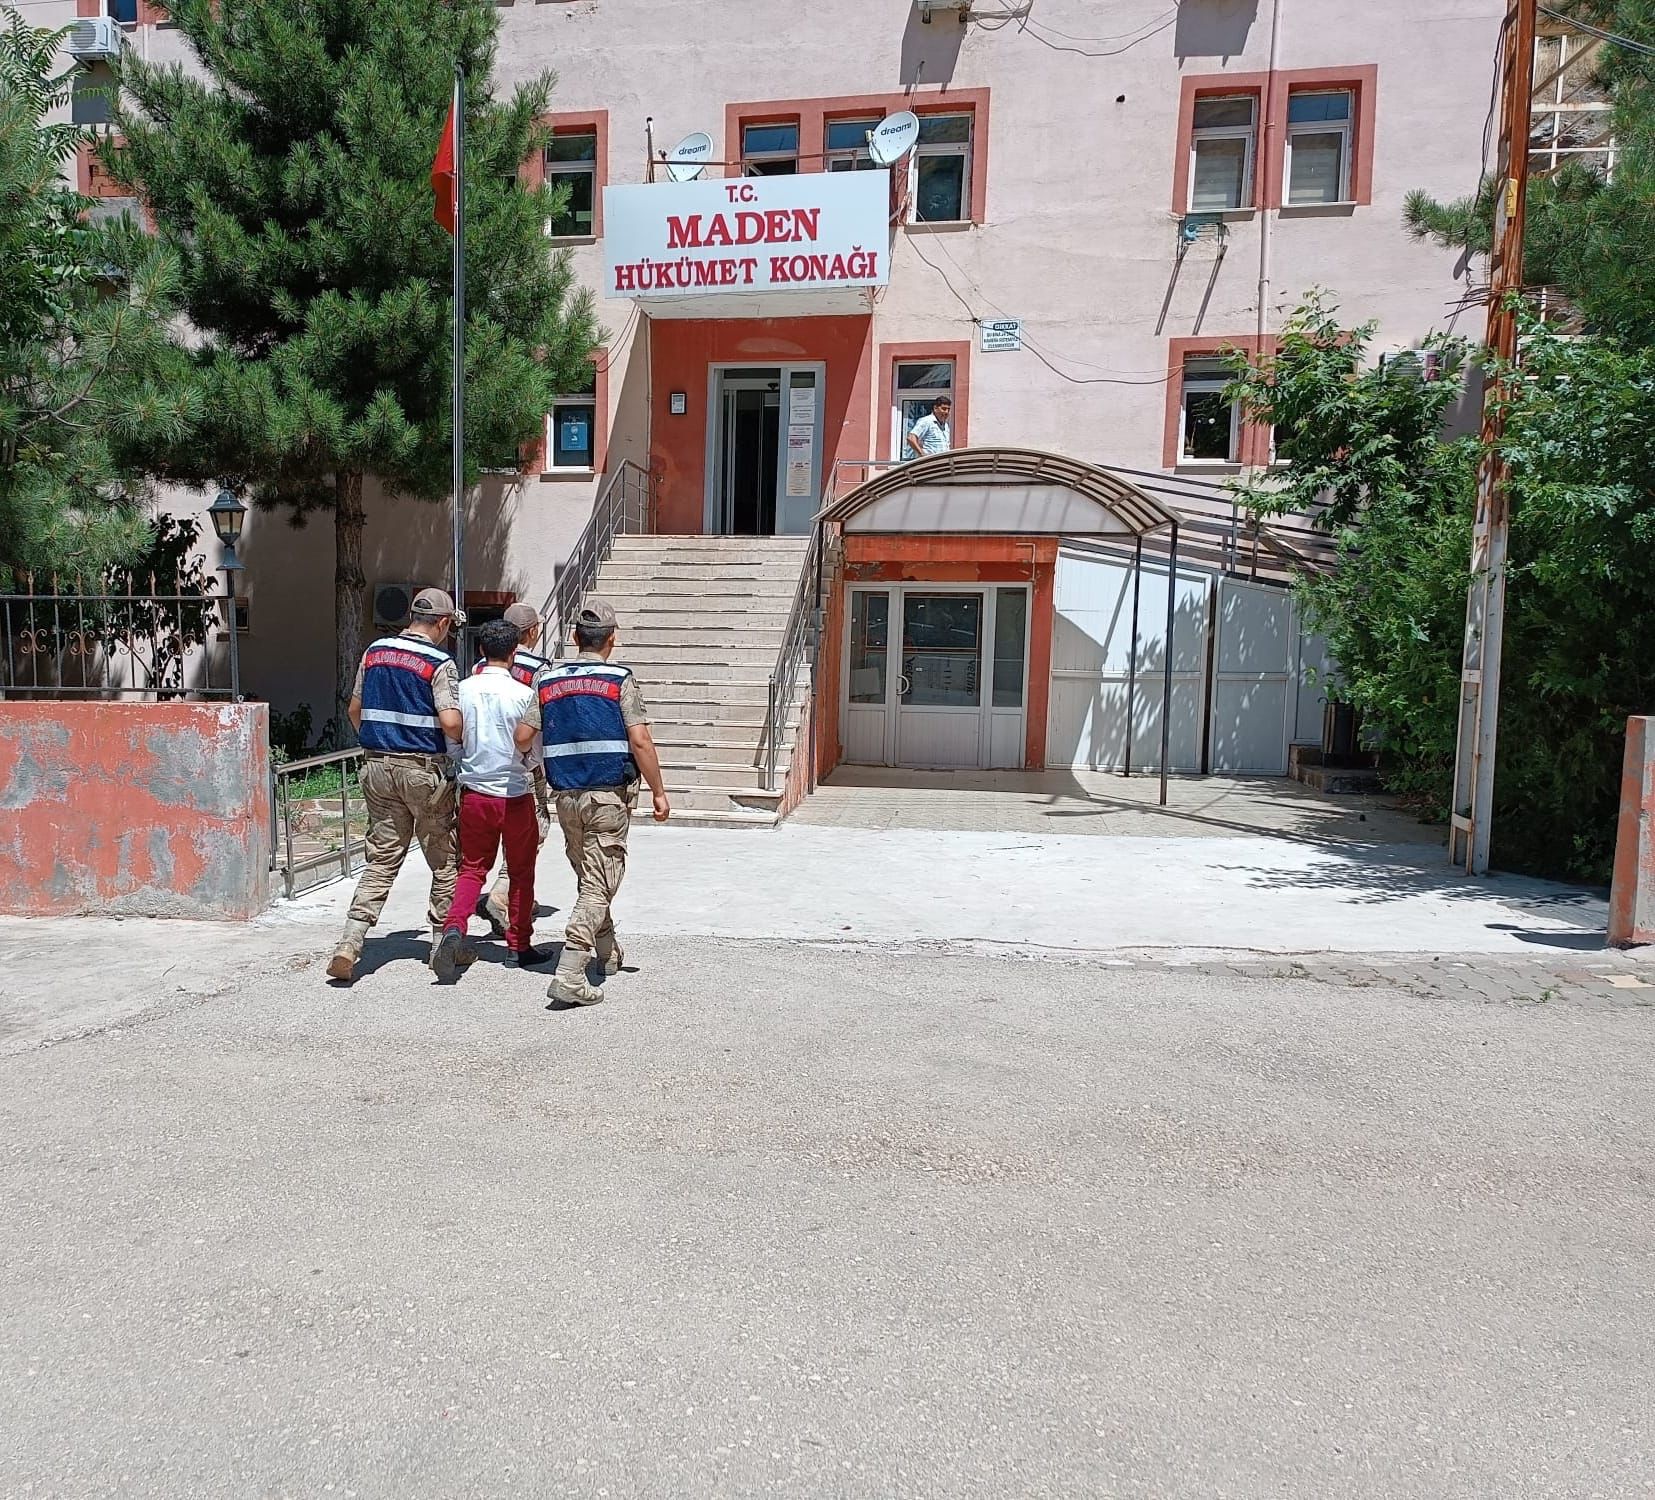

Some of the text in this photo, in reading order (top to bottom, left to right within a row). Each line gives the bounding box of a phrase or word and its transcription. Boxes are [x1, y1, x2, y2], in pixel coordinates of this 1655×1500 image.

[725, 184, 758, 203] T.C.
[666, 208, 821, 249] MADEN
[614, 245, 877, 291] HÜKÜMET KONAĞI
[547, 678, 610, 698] JANDARMA
